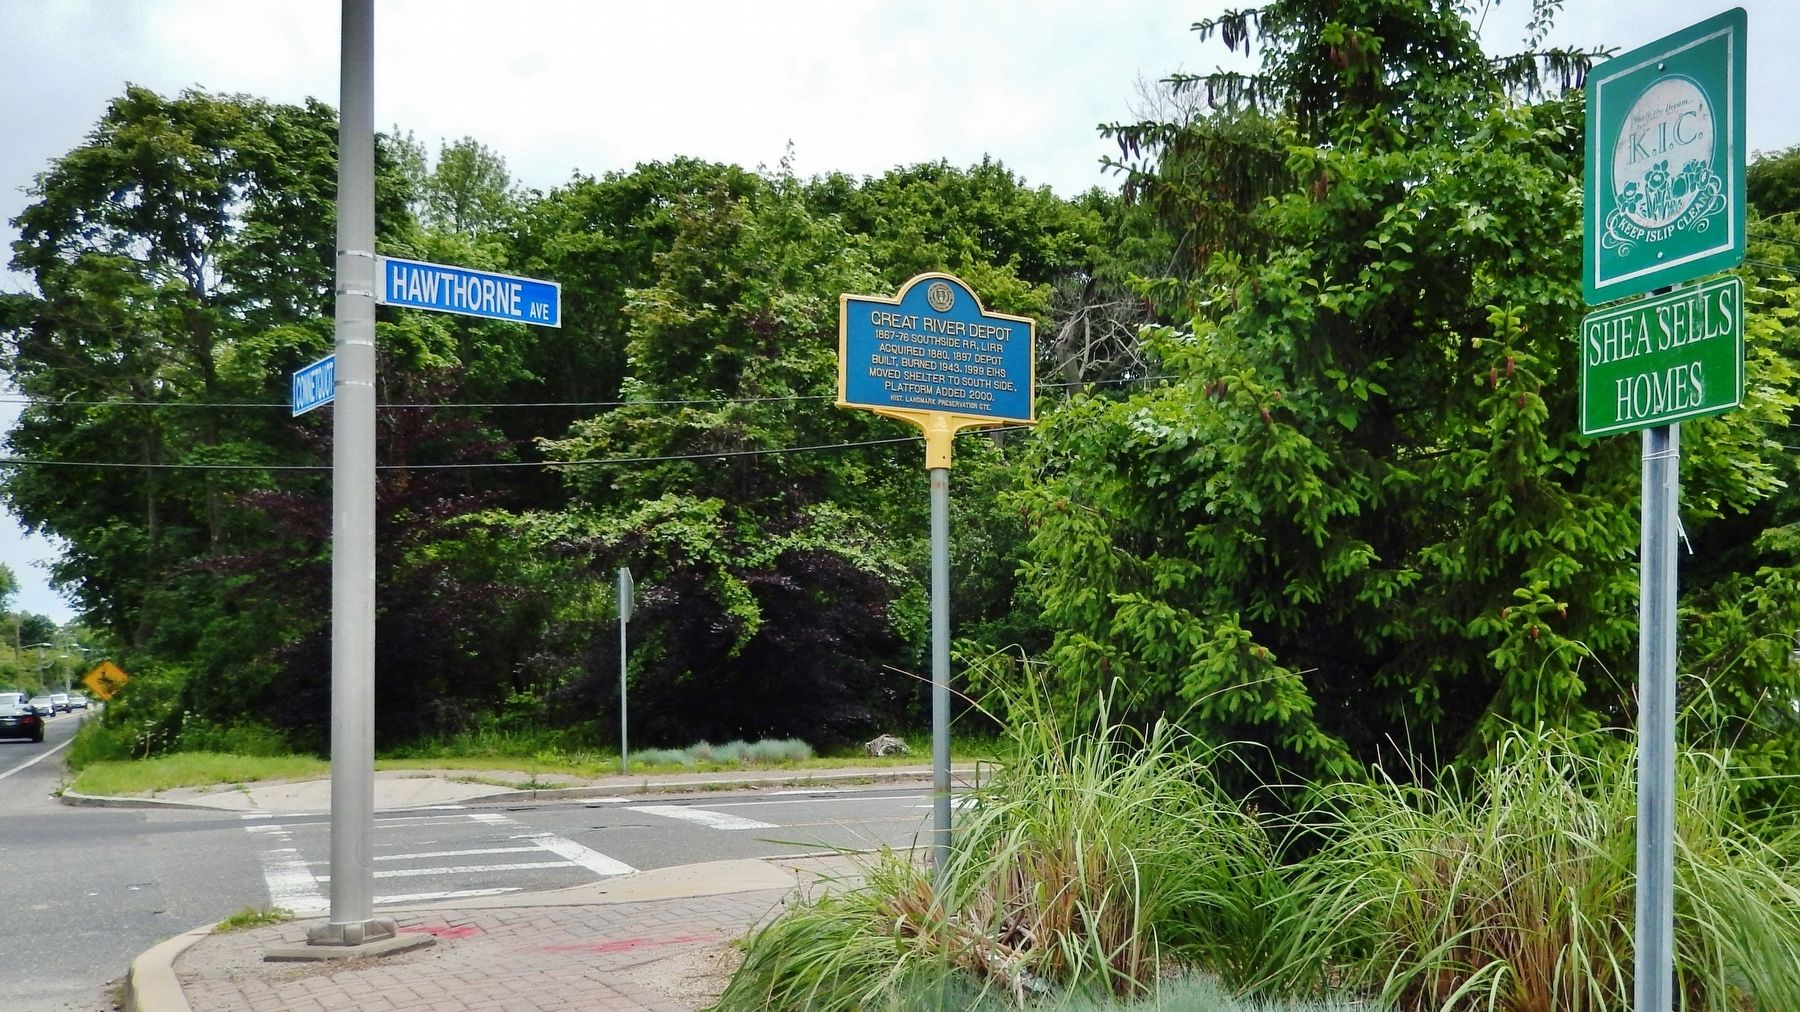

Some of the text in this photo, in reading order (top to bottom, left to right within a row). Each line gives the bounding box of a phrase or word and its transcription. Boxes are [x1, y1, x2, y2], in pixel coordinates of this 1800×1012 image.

[1618, 192, 1709, 242] KEEP ISLIP CLEAN
[392, 264, 549, 322] HAWTHORNE AVE
[871, 311, 1012, 342] GREAT RIVER DEPOT
[1589, 288, 1732, 367] SHEA SELLS
[879, 343, 1003, 366] ACQUIRED 1880. 1897 DEPOT
[911, 333, 961, 348] SOUTHSIDE
[962, 339, 979, 351] RR,
[981, 342, 1003, 353] LIRR
[869, 366, 1018, 392] MOVED SHELTER TO SOUTH SIDE.
[871, 354, 1006, 378] BUILT, BURNED 1943. 1999 EIHS
[884, 380, 995, 402] PLATFORM ADDED 2000.
[905, 396, 936, 405] LANDMARK
[937, 399, 978, 409] PRESERVATION
[1615, 361, 1702, 422] HOMES
